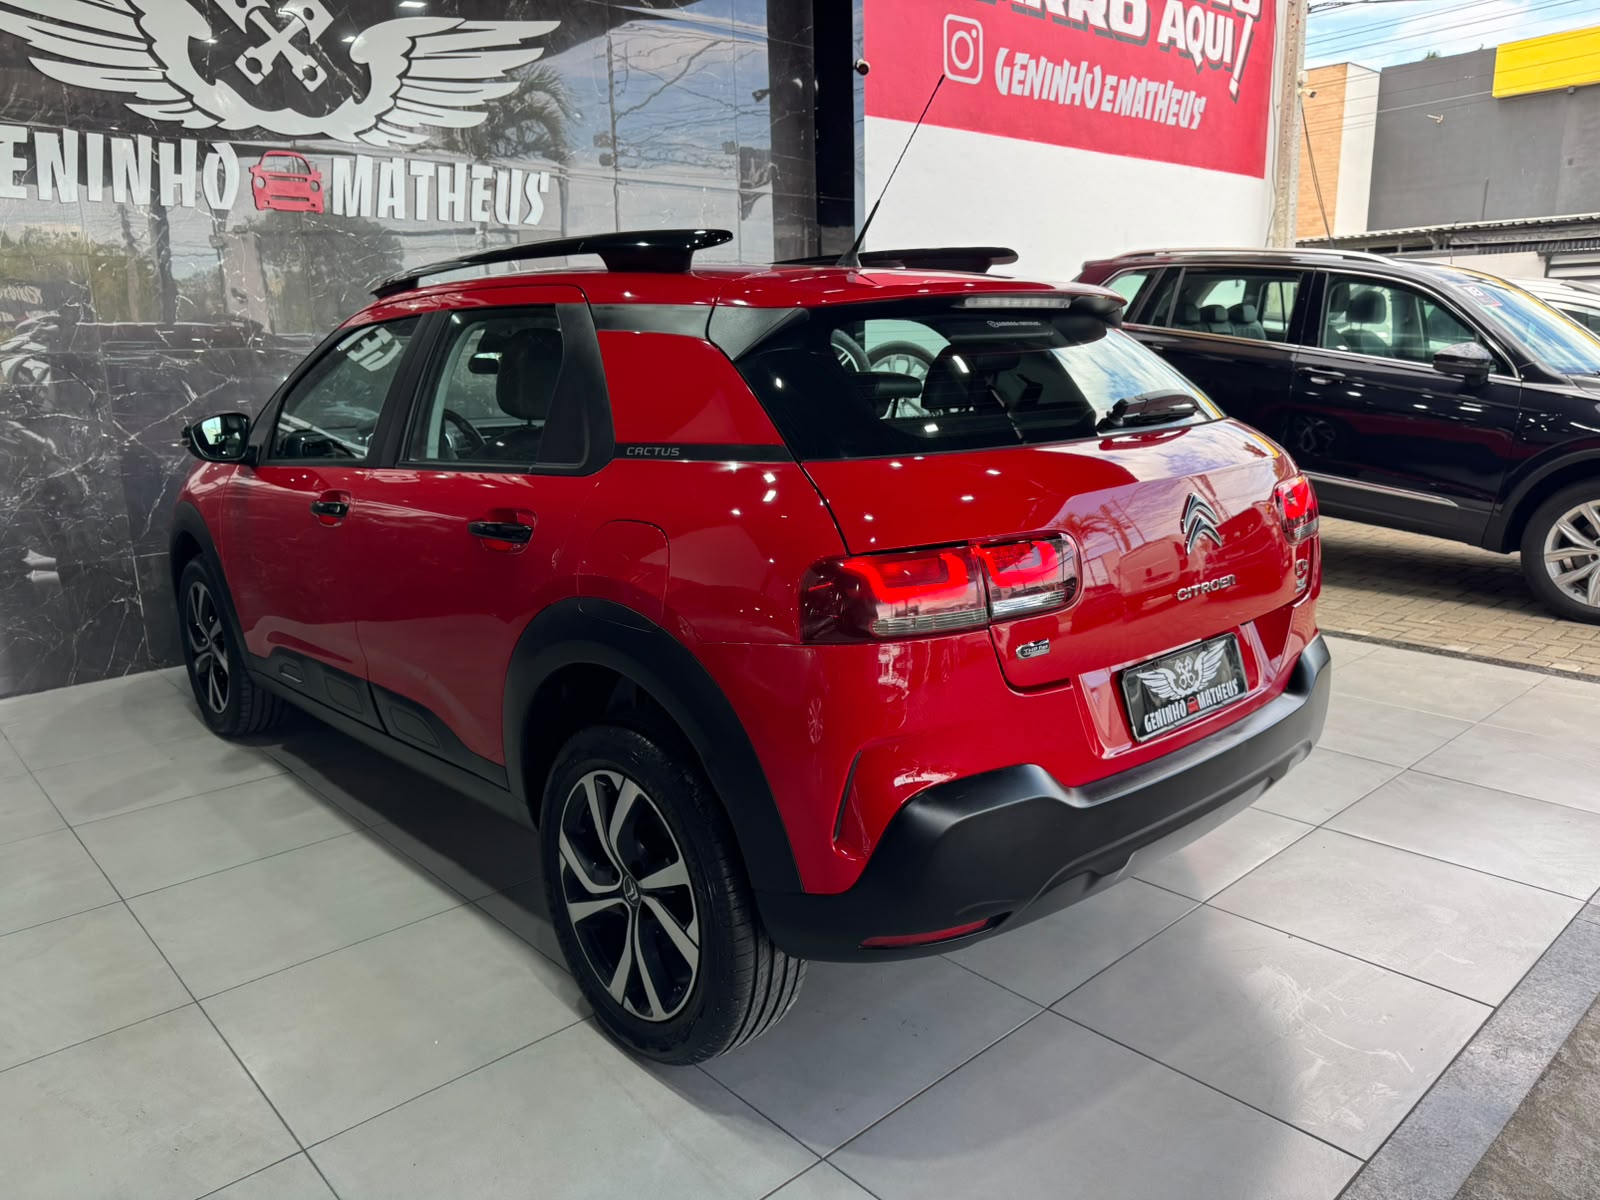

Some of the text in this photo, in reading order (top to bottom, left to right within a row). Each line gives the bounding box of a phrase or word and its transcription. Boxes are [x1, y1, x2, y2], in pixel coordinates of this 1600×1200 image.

[1156, 0, 1255, 98] AQUI!
[0, 123, 549, 226] ENINHO MATHEUS
[626, 446, 680, 457] CACTUS
[1144, 678, 1239, 733] GENINHO MATHEUS
